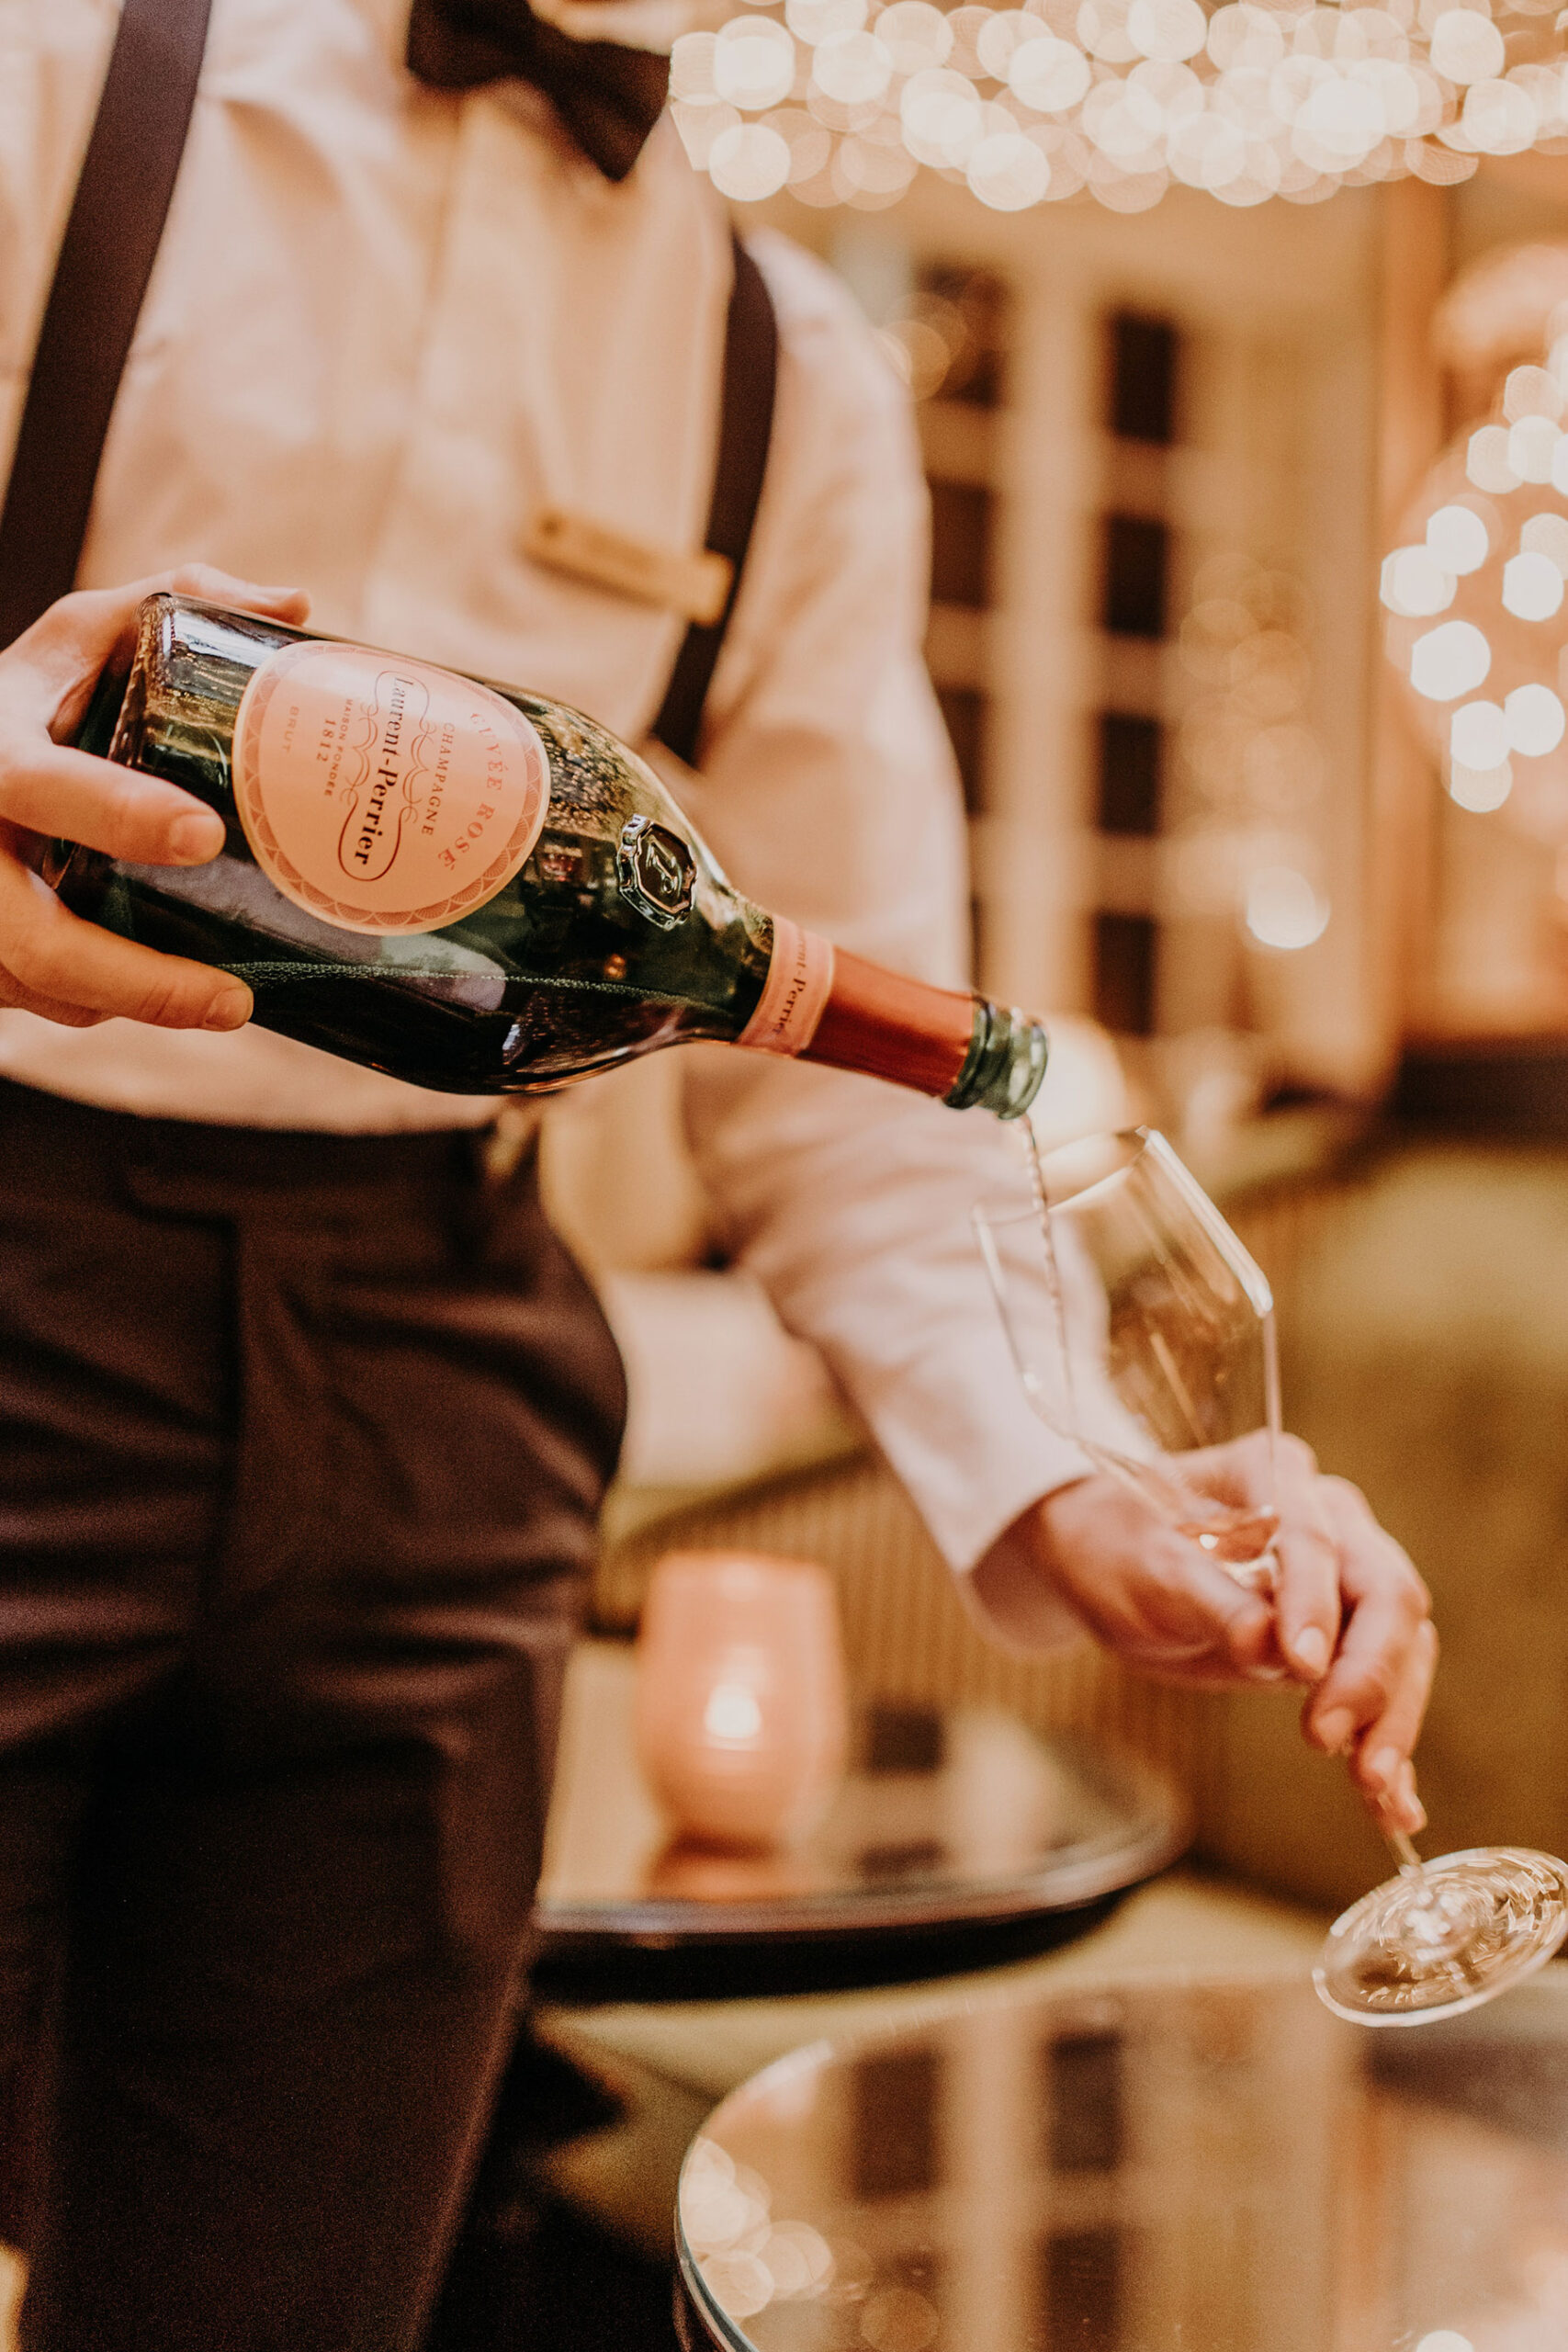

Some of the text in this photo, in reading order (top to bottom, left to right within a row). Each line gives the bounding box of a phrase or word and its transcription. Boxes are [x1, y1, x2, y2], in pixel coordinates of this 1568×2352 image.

[281, 706, 299, 753] BRUT
[316, 718, 336, 762] 1812
[338, 698, 354, 741] MAISON
[354, 677, 414, 865] Laurent-Perrier
[421, 722, 456, 836] CHAMPAGNE
[437, 802, 495, 872] ROSÉ
